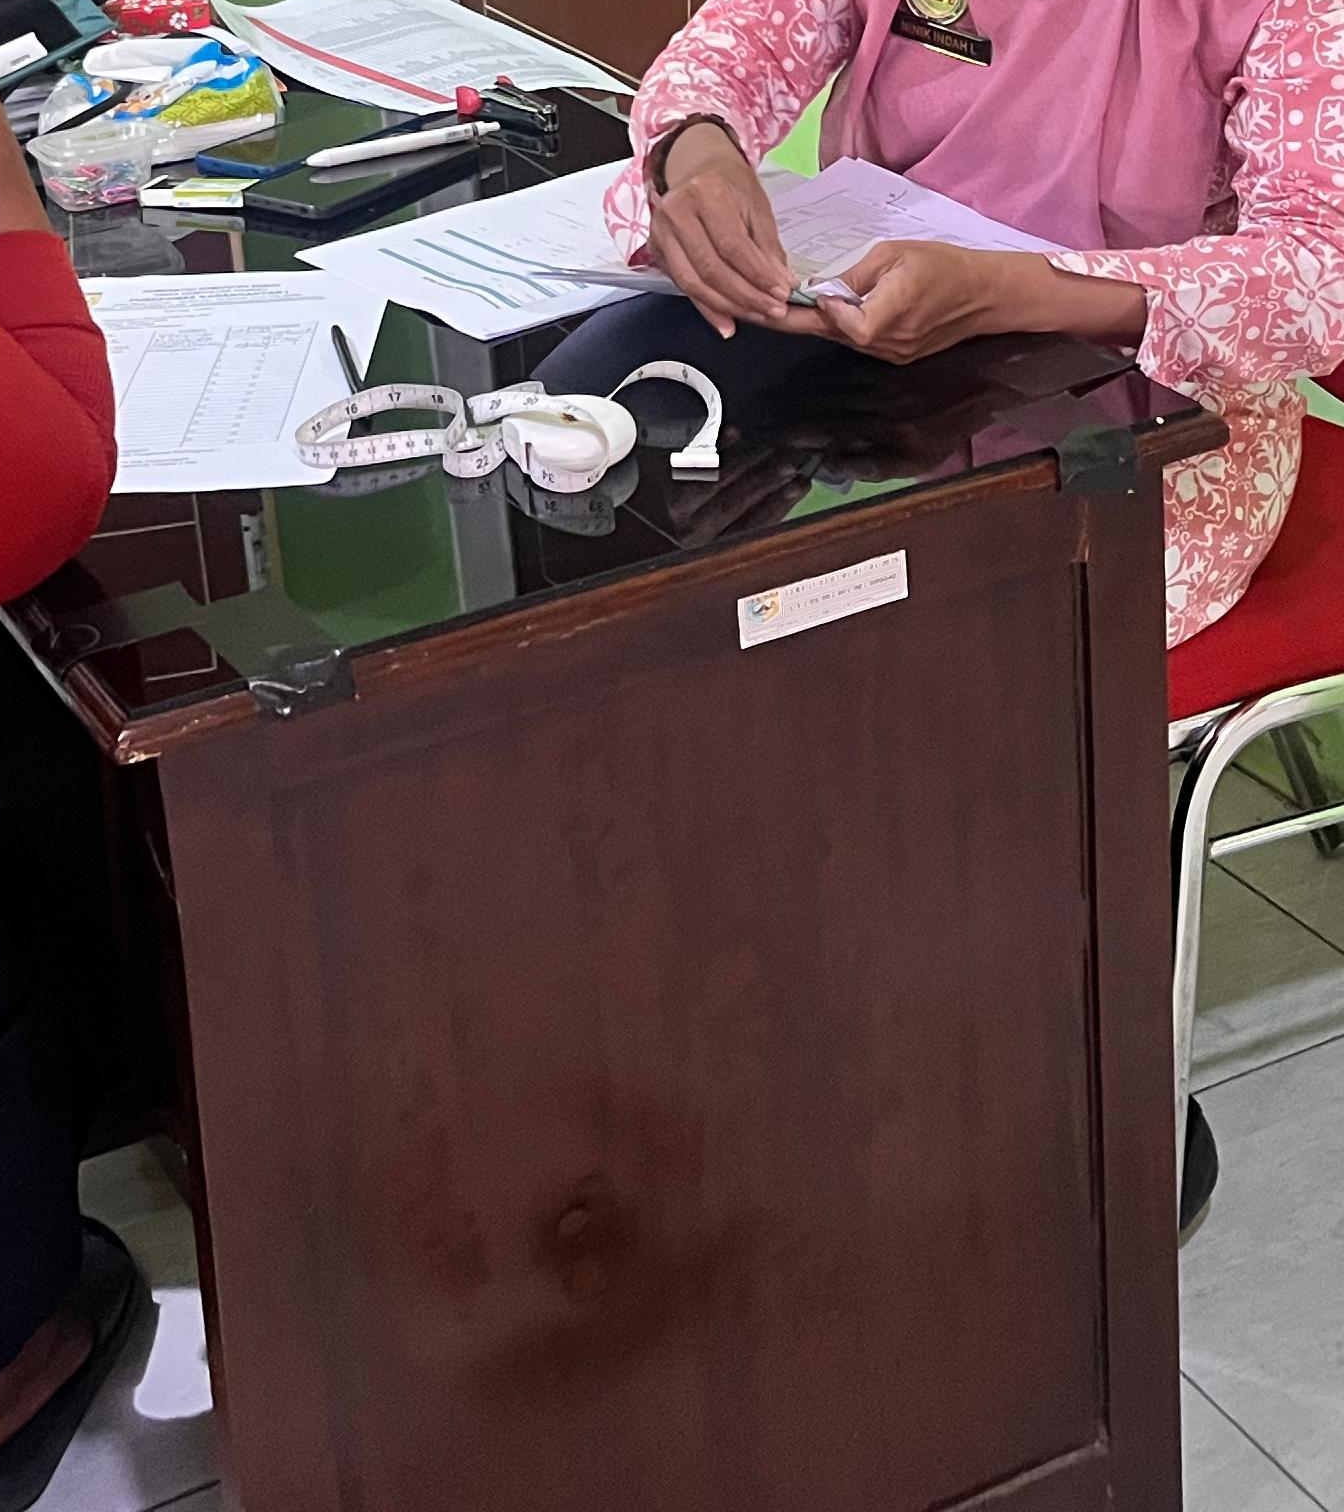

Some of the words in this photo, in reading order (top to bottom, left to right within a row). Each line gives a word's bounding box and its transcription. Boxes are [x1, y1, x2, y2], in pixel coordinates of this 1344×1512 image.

[346, 403, 358, 415] 16
[388, 391, 401, 402] 17
[432, 394, 443, 404] 18
[476, 455, 489, 469] 22
